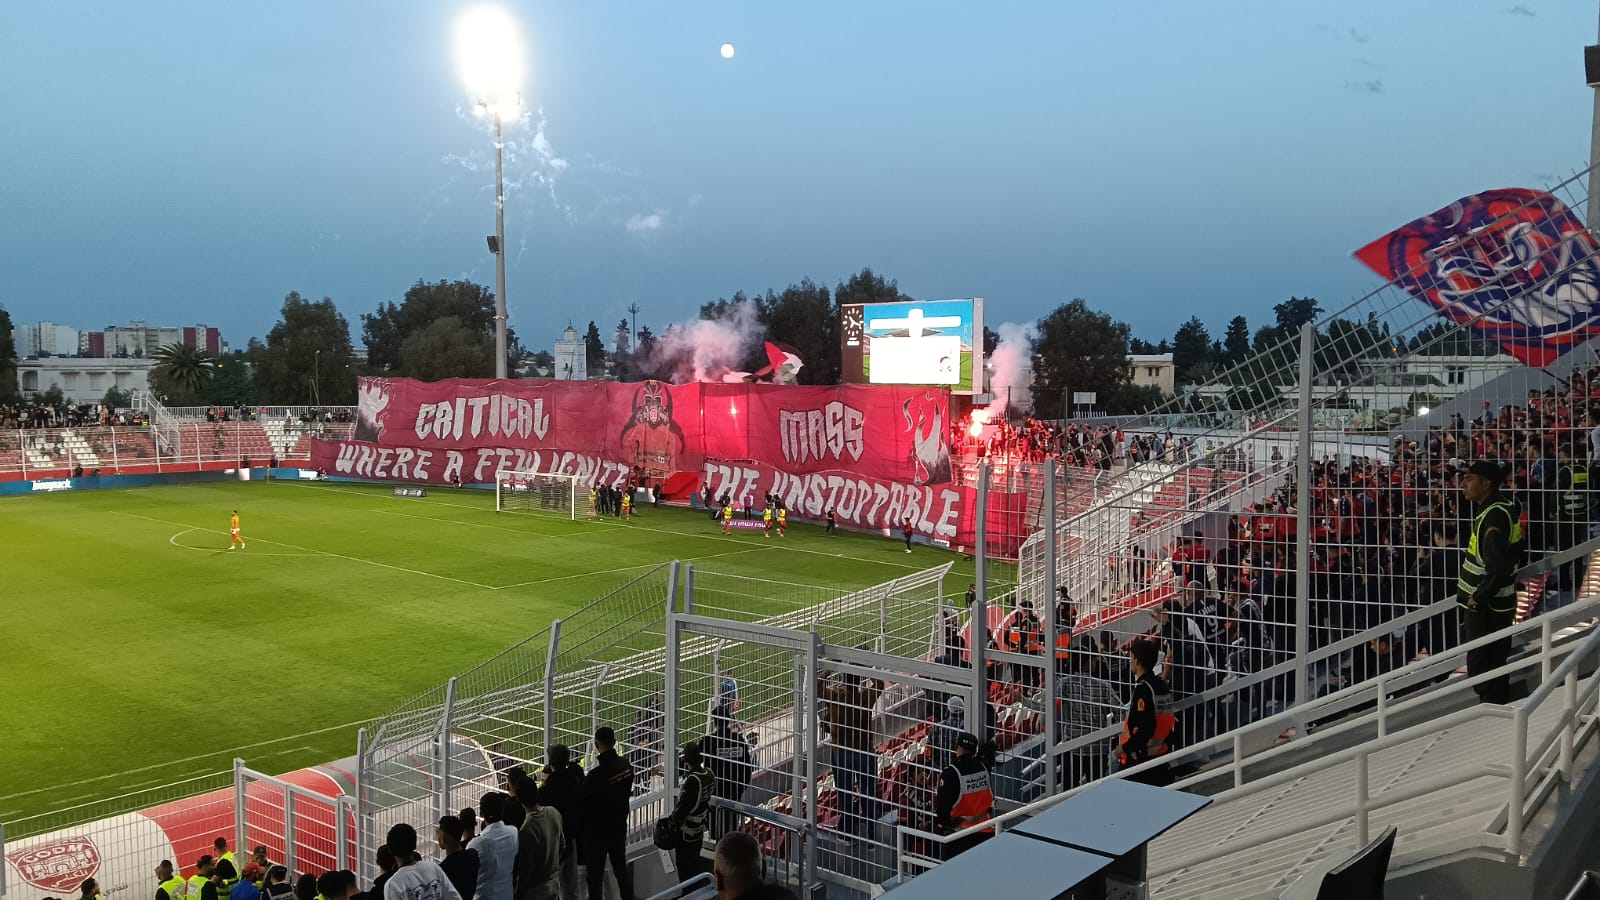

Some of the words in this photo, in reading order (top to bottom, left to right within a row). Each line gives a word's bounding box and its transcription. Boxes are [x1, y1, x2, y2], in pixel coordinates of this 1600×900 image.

[415, 394, 549, 441] CRITICAL
[780, 401, 864, 464] MASS
[335, 443, 433, 480] WHERE
[443, 450, 464, 483] A
[474, 448, 541, 483] FEW
[547, 451, 630, 492] IGNITE
[701, 462, 760, 506] THE
[768, 470, 960, 538] UNSTOPPABLE
[1206, 613, 1220, 633] 9
[966, 779, 988, 790] POLICE
[22, 843, 84, 863] CODM
